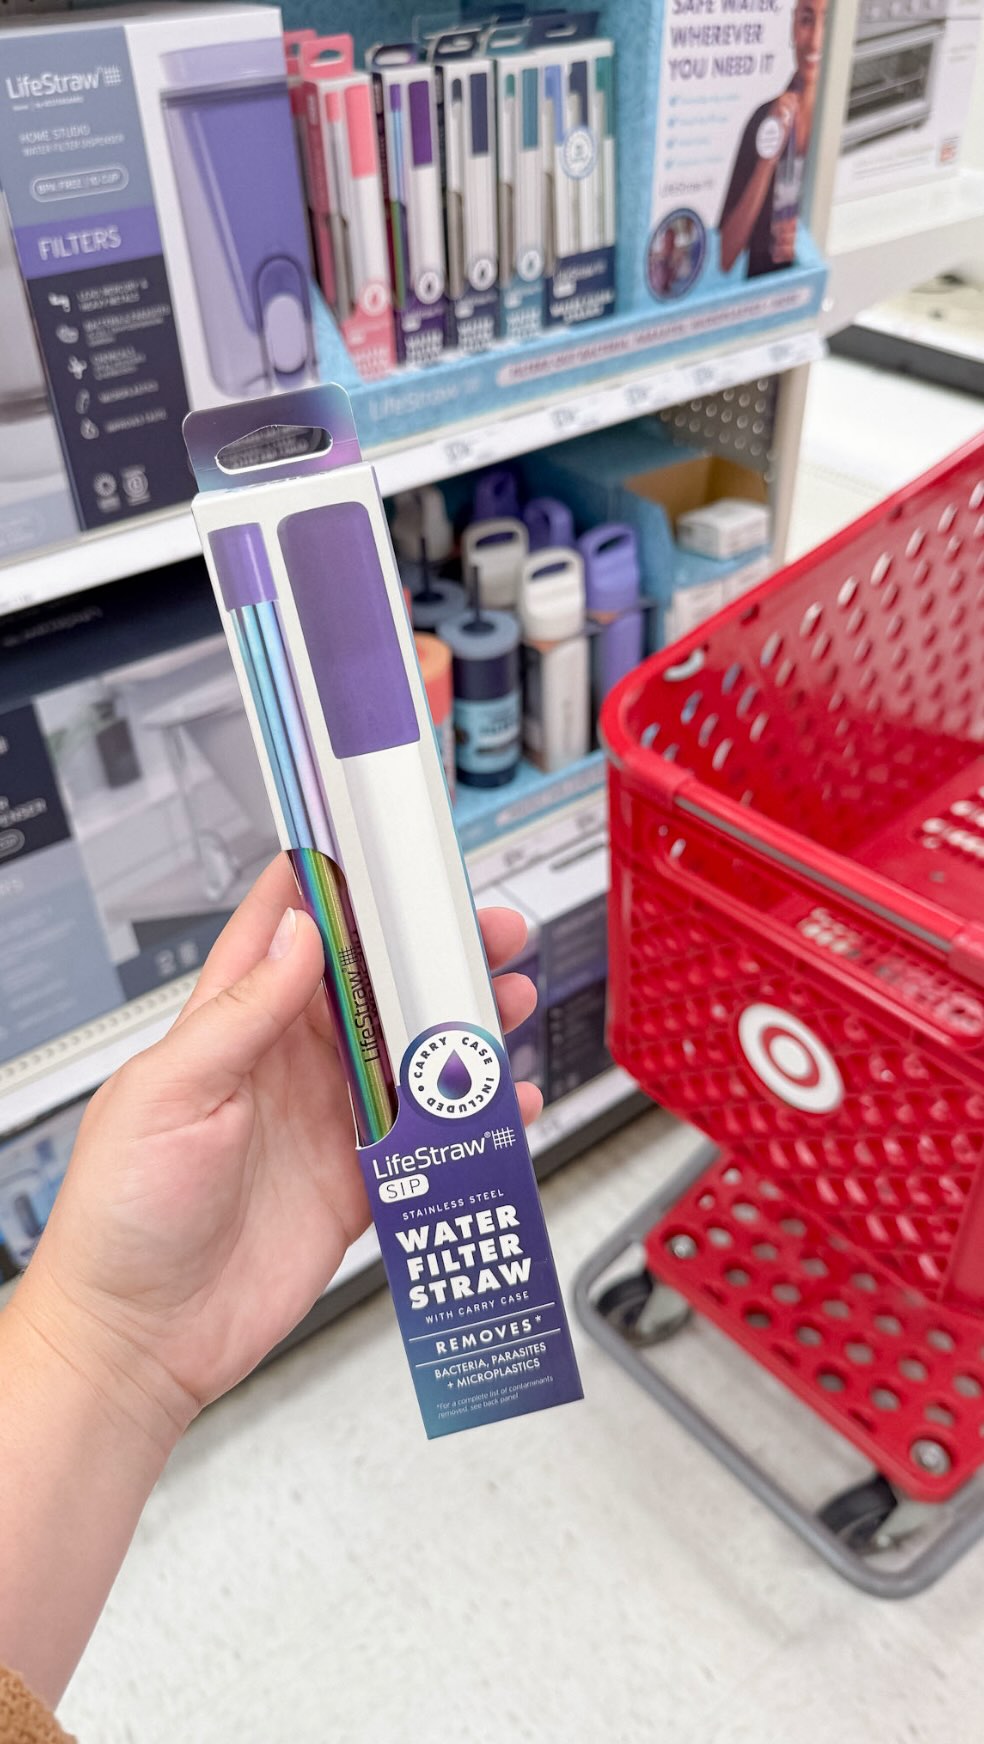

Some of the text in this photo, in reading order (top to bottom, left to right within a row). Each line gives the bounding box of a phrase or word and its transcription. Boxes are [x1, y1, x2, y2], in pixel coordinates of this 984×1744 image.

[670, 23, 763, 48] WHEREVER
[668, 53, 775, 81] YOU NEED IT
[38, 224, 123, 261] FILTERS
[413, 1036, 494, 1113] CARRY CASE INCLUDED
[386, 1178, 422, 1199] SIP
[402, 1188, 505, 1221] STAINLESS STEEL
[395, 1204, 521, 1254] WATER
[406, 1233, 524, 1282] FILTER
[408, 1258, 532, 1310] STRAW
[425, 1290, 530, 1325] WITH CARRY CASE
[434, 1341, 547, 1380] BACTERIA, PARASITES
[456, 1357, 540, 1388] MICROPLASTICS
[457, 1392, 489, 1406] complete
[489, 1388, 500, 1399] list
[508, 1375, 554, 1393] contaminants
[470, 1402, 482, 1412] see
[483, 1398, 499, 1408] back
[499, 1391, 519, 1404] panel
